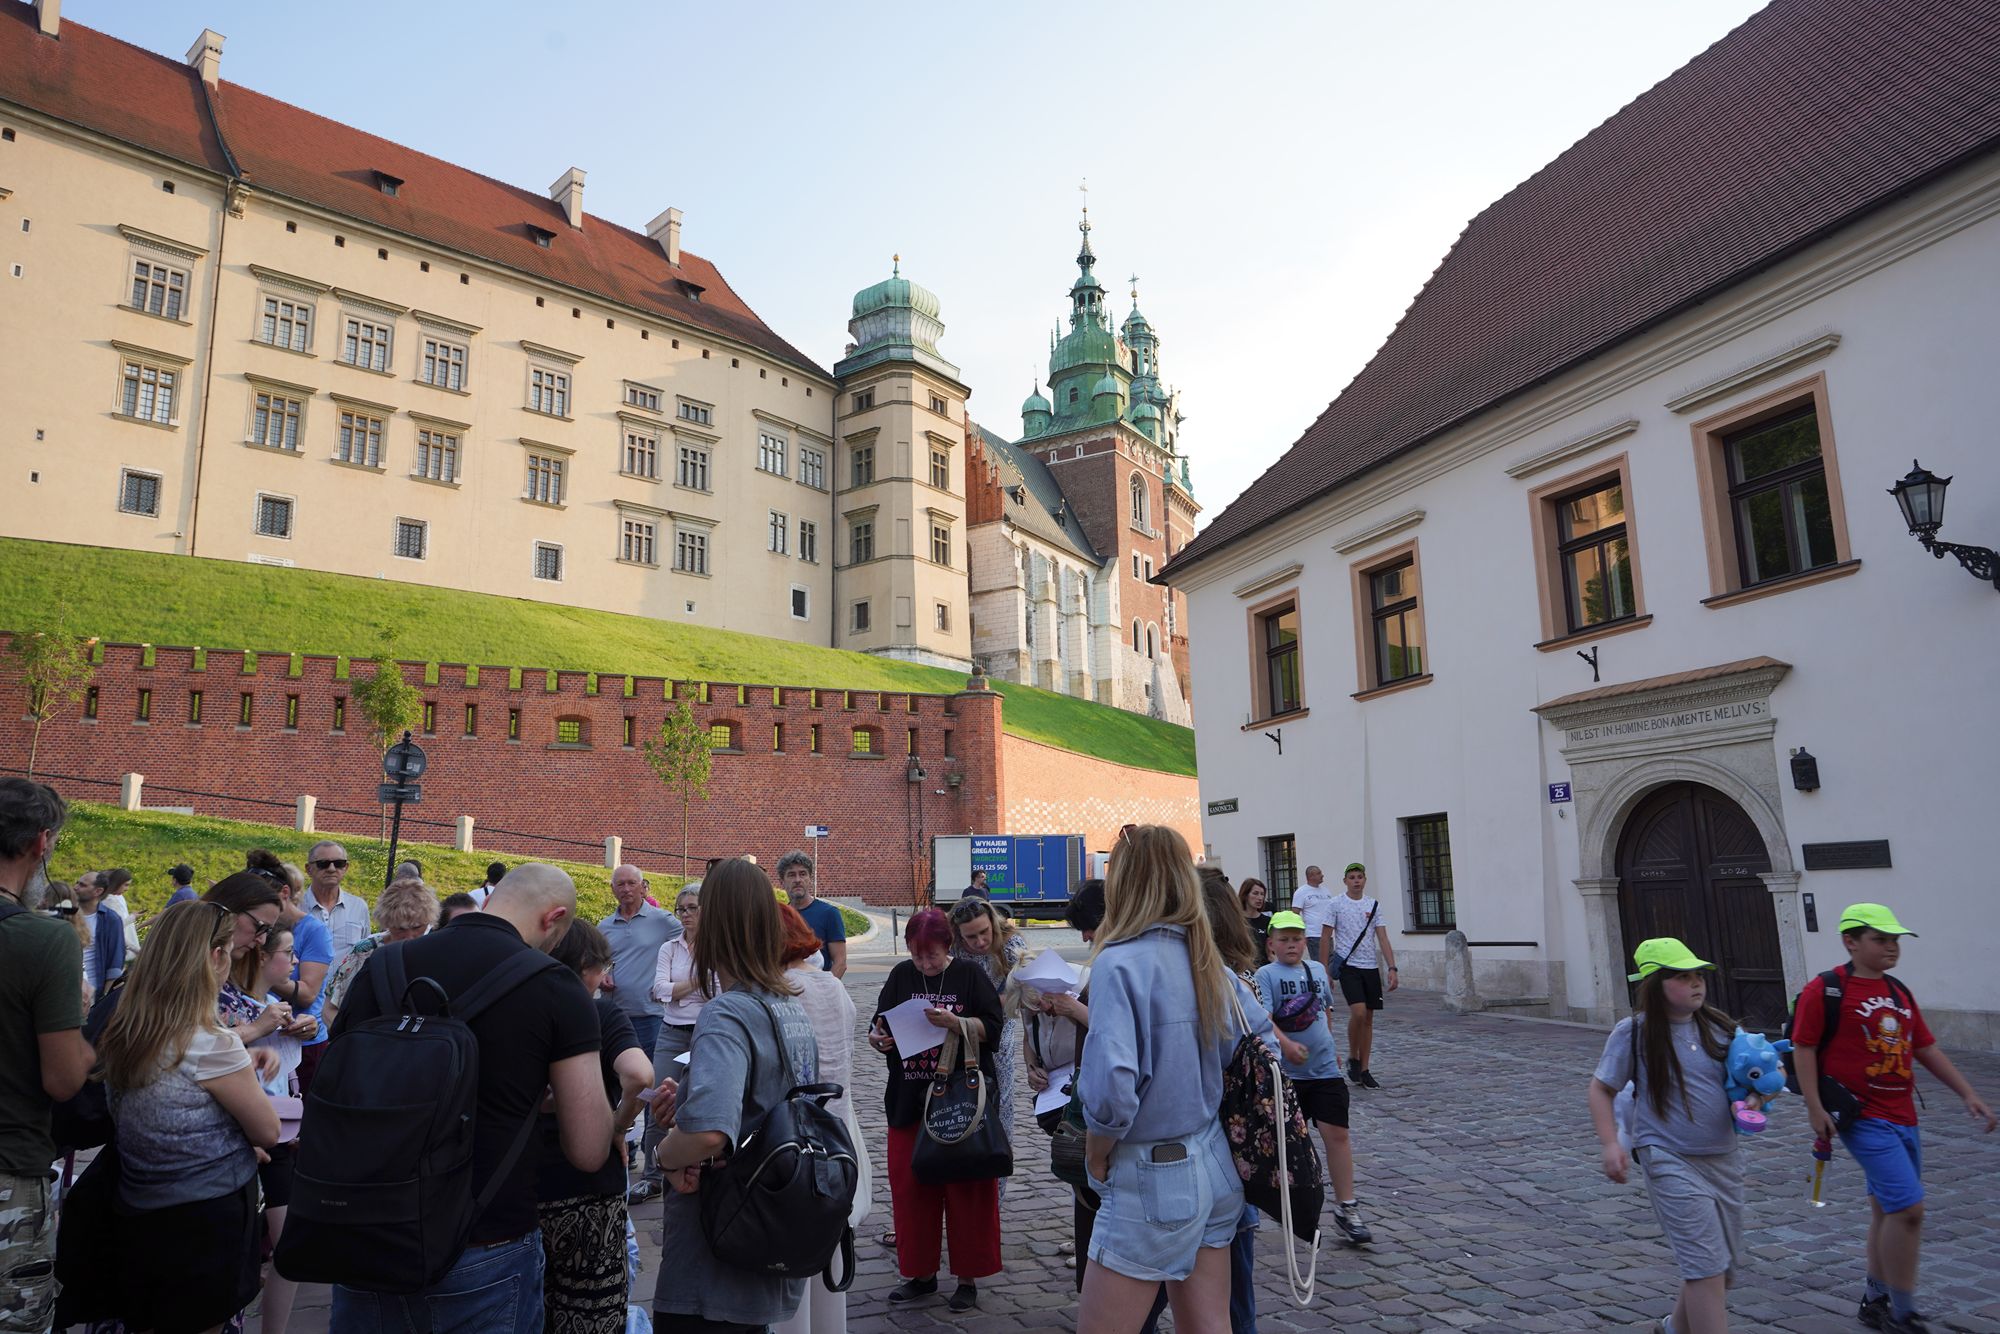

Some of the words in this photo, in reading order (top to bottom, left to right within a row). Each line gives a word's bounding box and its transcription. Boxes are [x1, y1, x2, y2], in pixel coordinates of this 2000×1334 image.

[1602, 726, 1613, 737] IN
[1615, 720, 1649, 735] HOMINE
[1555, 788, 1564, 798] 25
[911, 993, 957, 1002] HOPELESS
[1855, 996, 1912, 1019] LASAGA
[927, 1118, 955, 1128] LAURA
